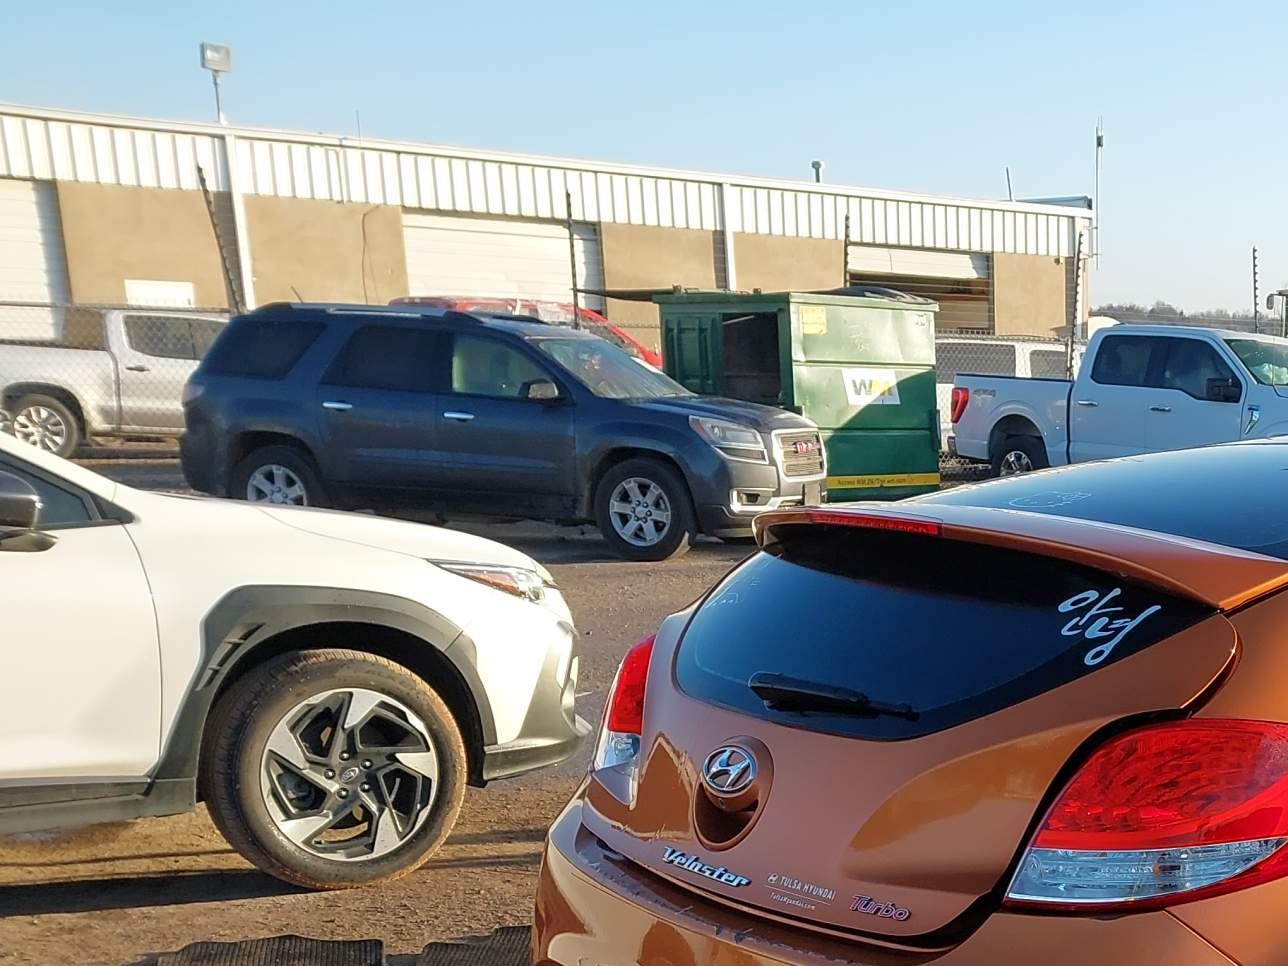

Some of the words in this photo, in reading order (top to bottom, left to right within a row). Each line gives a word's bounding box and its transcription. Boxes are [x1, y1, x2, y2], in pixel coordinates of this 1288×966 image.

[662, 846, 752, 889] Veloster
[779, 876, 801, 891] TULSA
[802, 882, 837, 901] HYUNDAI
[850, 895, 911, 922] Turbo
